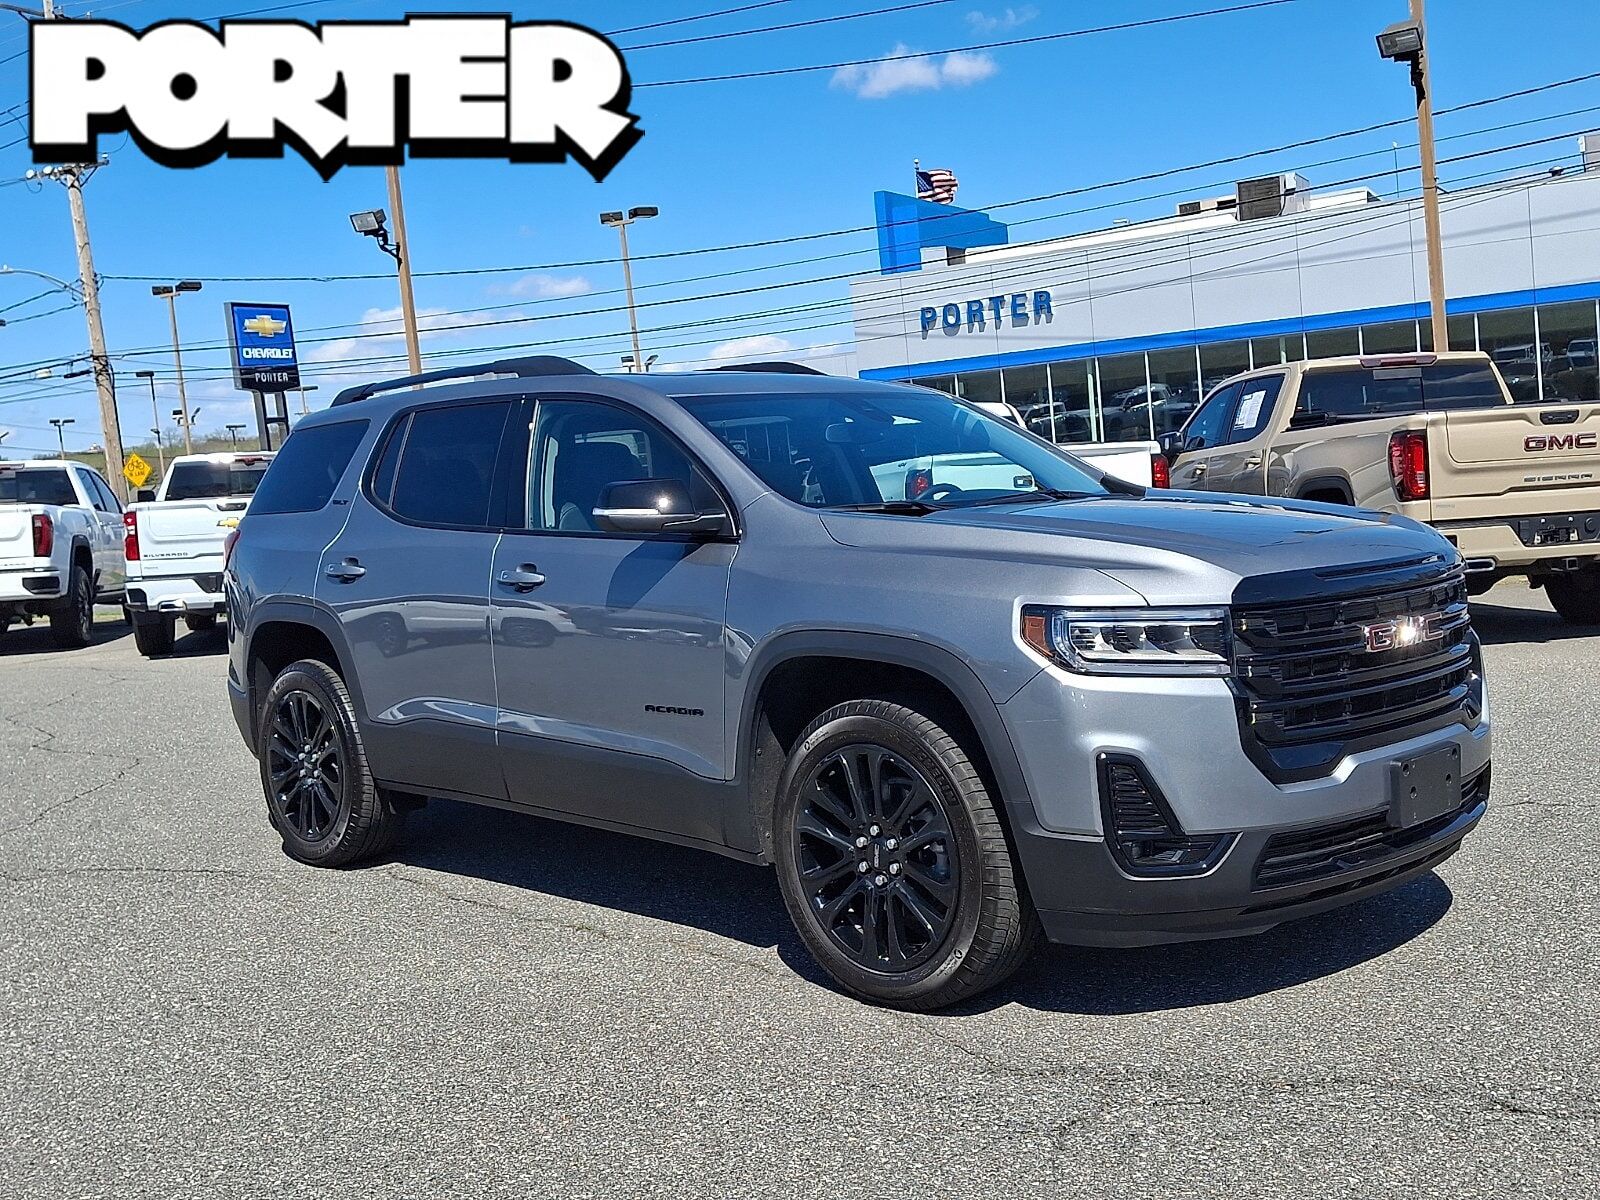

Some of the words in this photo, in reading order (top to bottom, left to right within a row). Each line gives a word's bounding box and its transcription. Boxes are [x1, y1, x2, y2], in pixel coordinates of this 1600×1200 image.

[920, 290, 1053, 333] PORTER
[242, 348, 293, 359] CHEVROLET
[255, 372, 289, 383] PORTER
[1524, 432, 1597, 452] GMC
[1524, 474, 1593, 482] SIERRA
[644, 704, 704, 716] ACADIA
